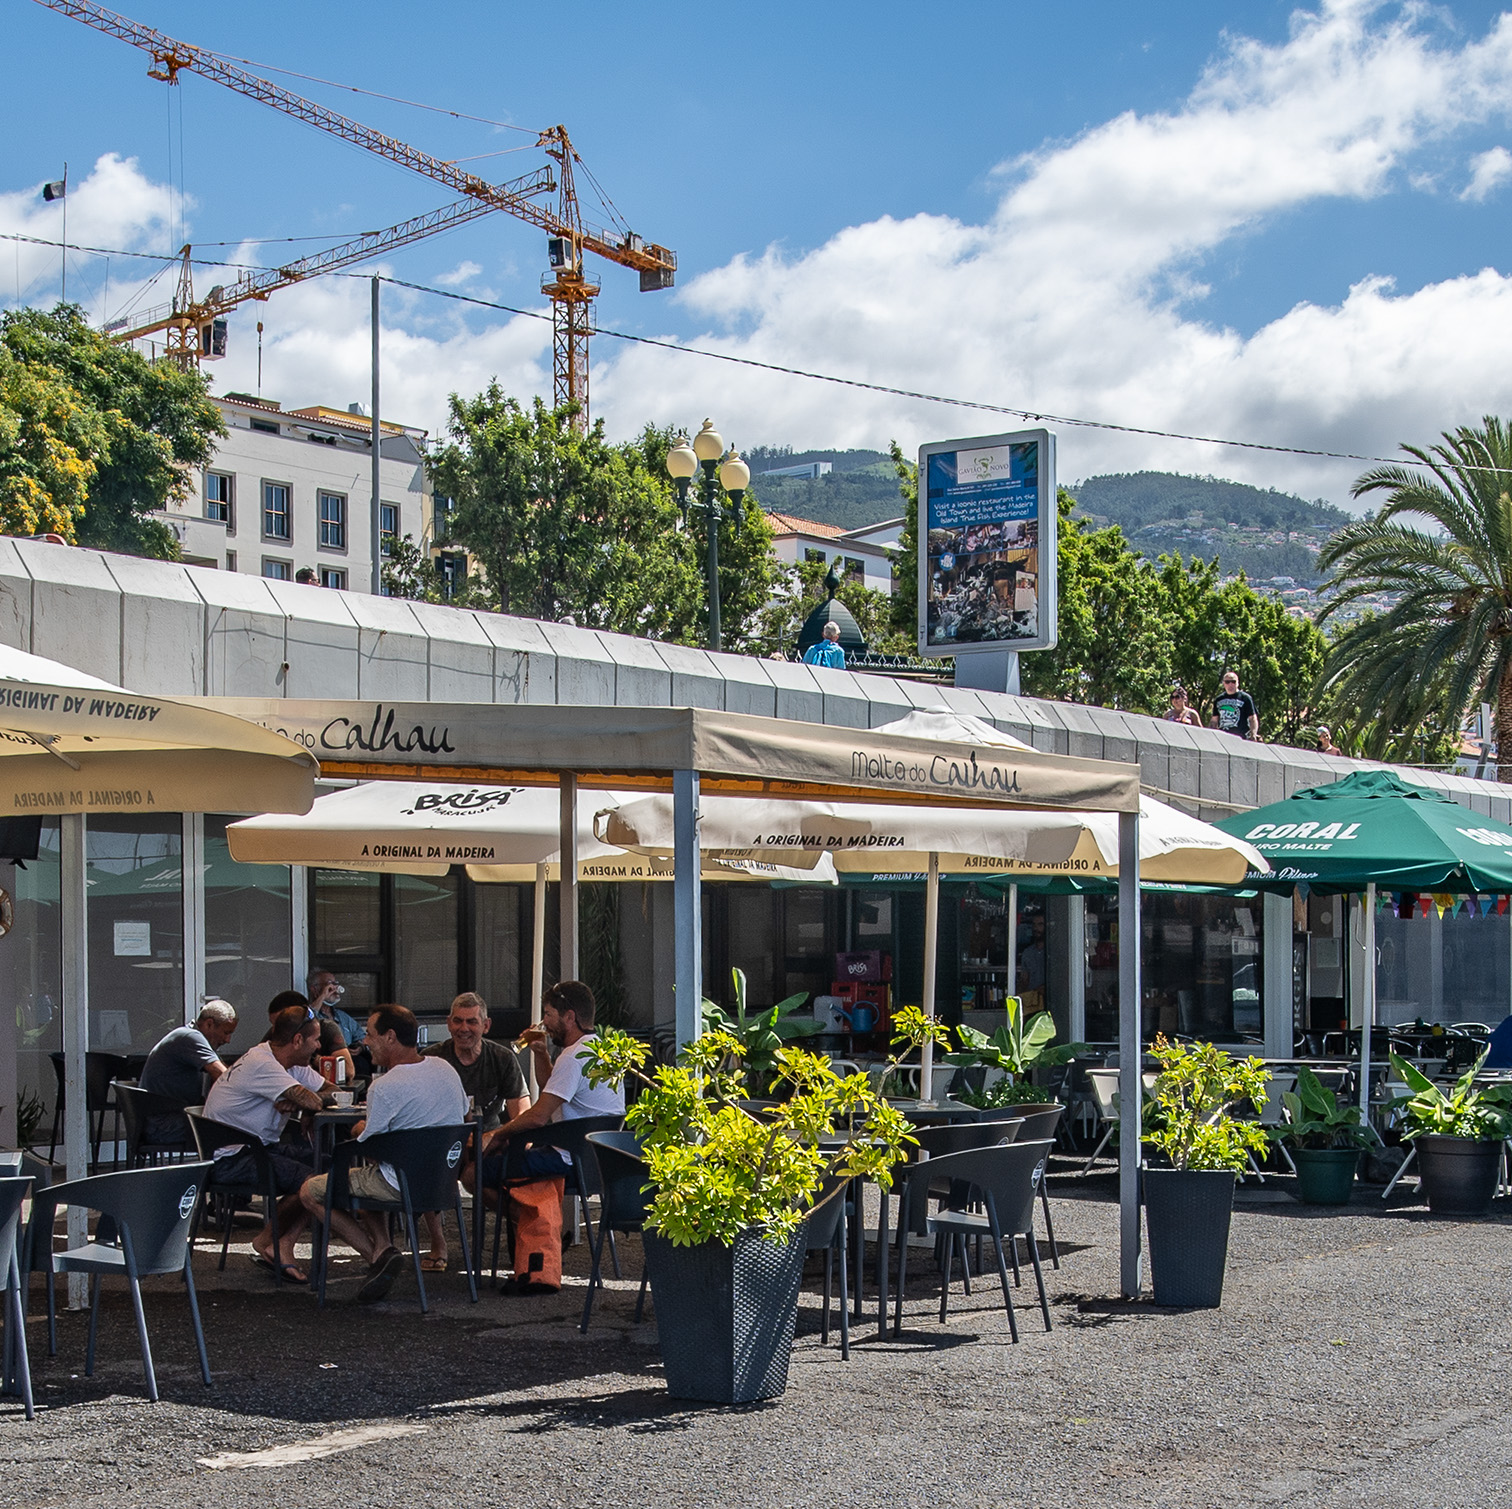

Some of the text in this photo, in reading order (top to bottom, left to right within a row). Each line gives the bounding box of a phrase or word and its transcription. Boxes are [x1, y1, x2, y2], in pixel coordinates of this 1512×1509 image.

[958, 463, 1009, 475] GAVIÃO NOVO
[934, 502, 950, 510] Visit
[978, 495, 1015, 507] restaurant
[935, 510, 947, 518] Old
[949, 508, 968, 516] Town
[969, 506, 981, 514] and
[995, 503, 1007, 511] the
[1008, 501, 1034, 510] Madeira
[940, 516, 958, 524] Island
[977, 512, 991, 521] Fish
[992, 509, 1030, 519] Experience!
[320, 704, 455, 753] Calhau
[909, 763, 927, 783] do
[1245, 822, 1362, 840] CORAL
[753, 834, 905, 848] A ORIGINAL DA MADEIRA
[361, 845, 495, 859] A ORIGINAL DA MADEIRA
